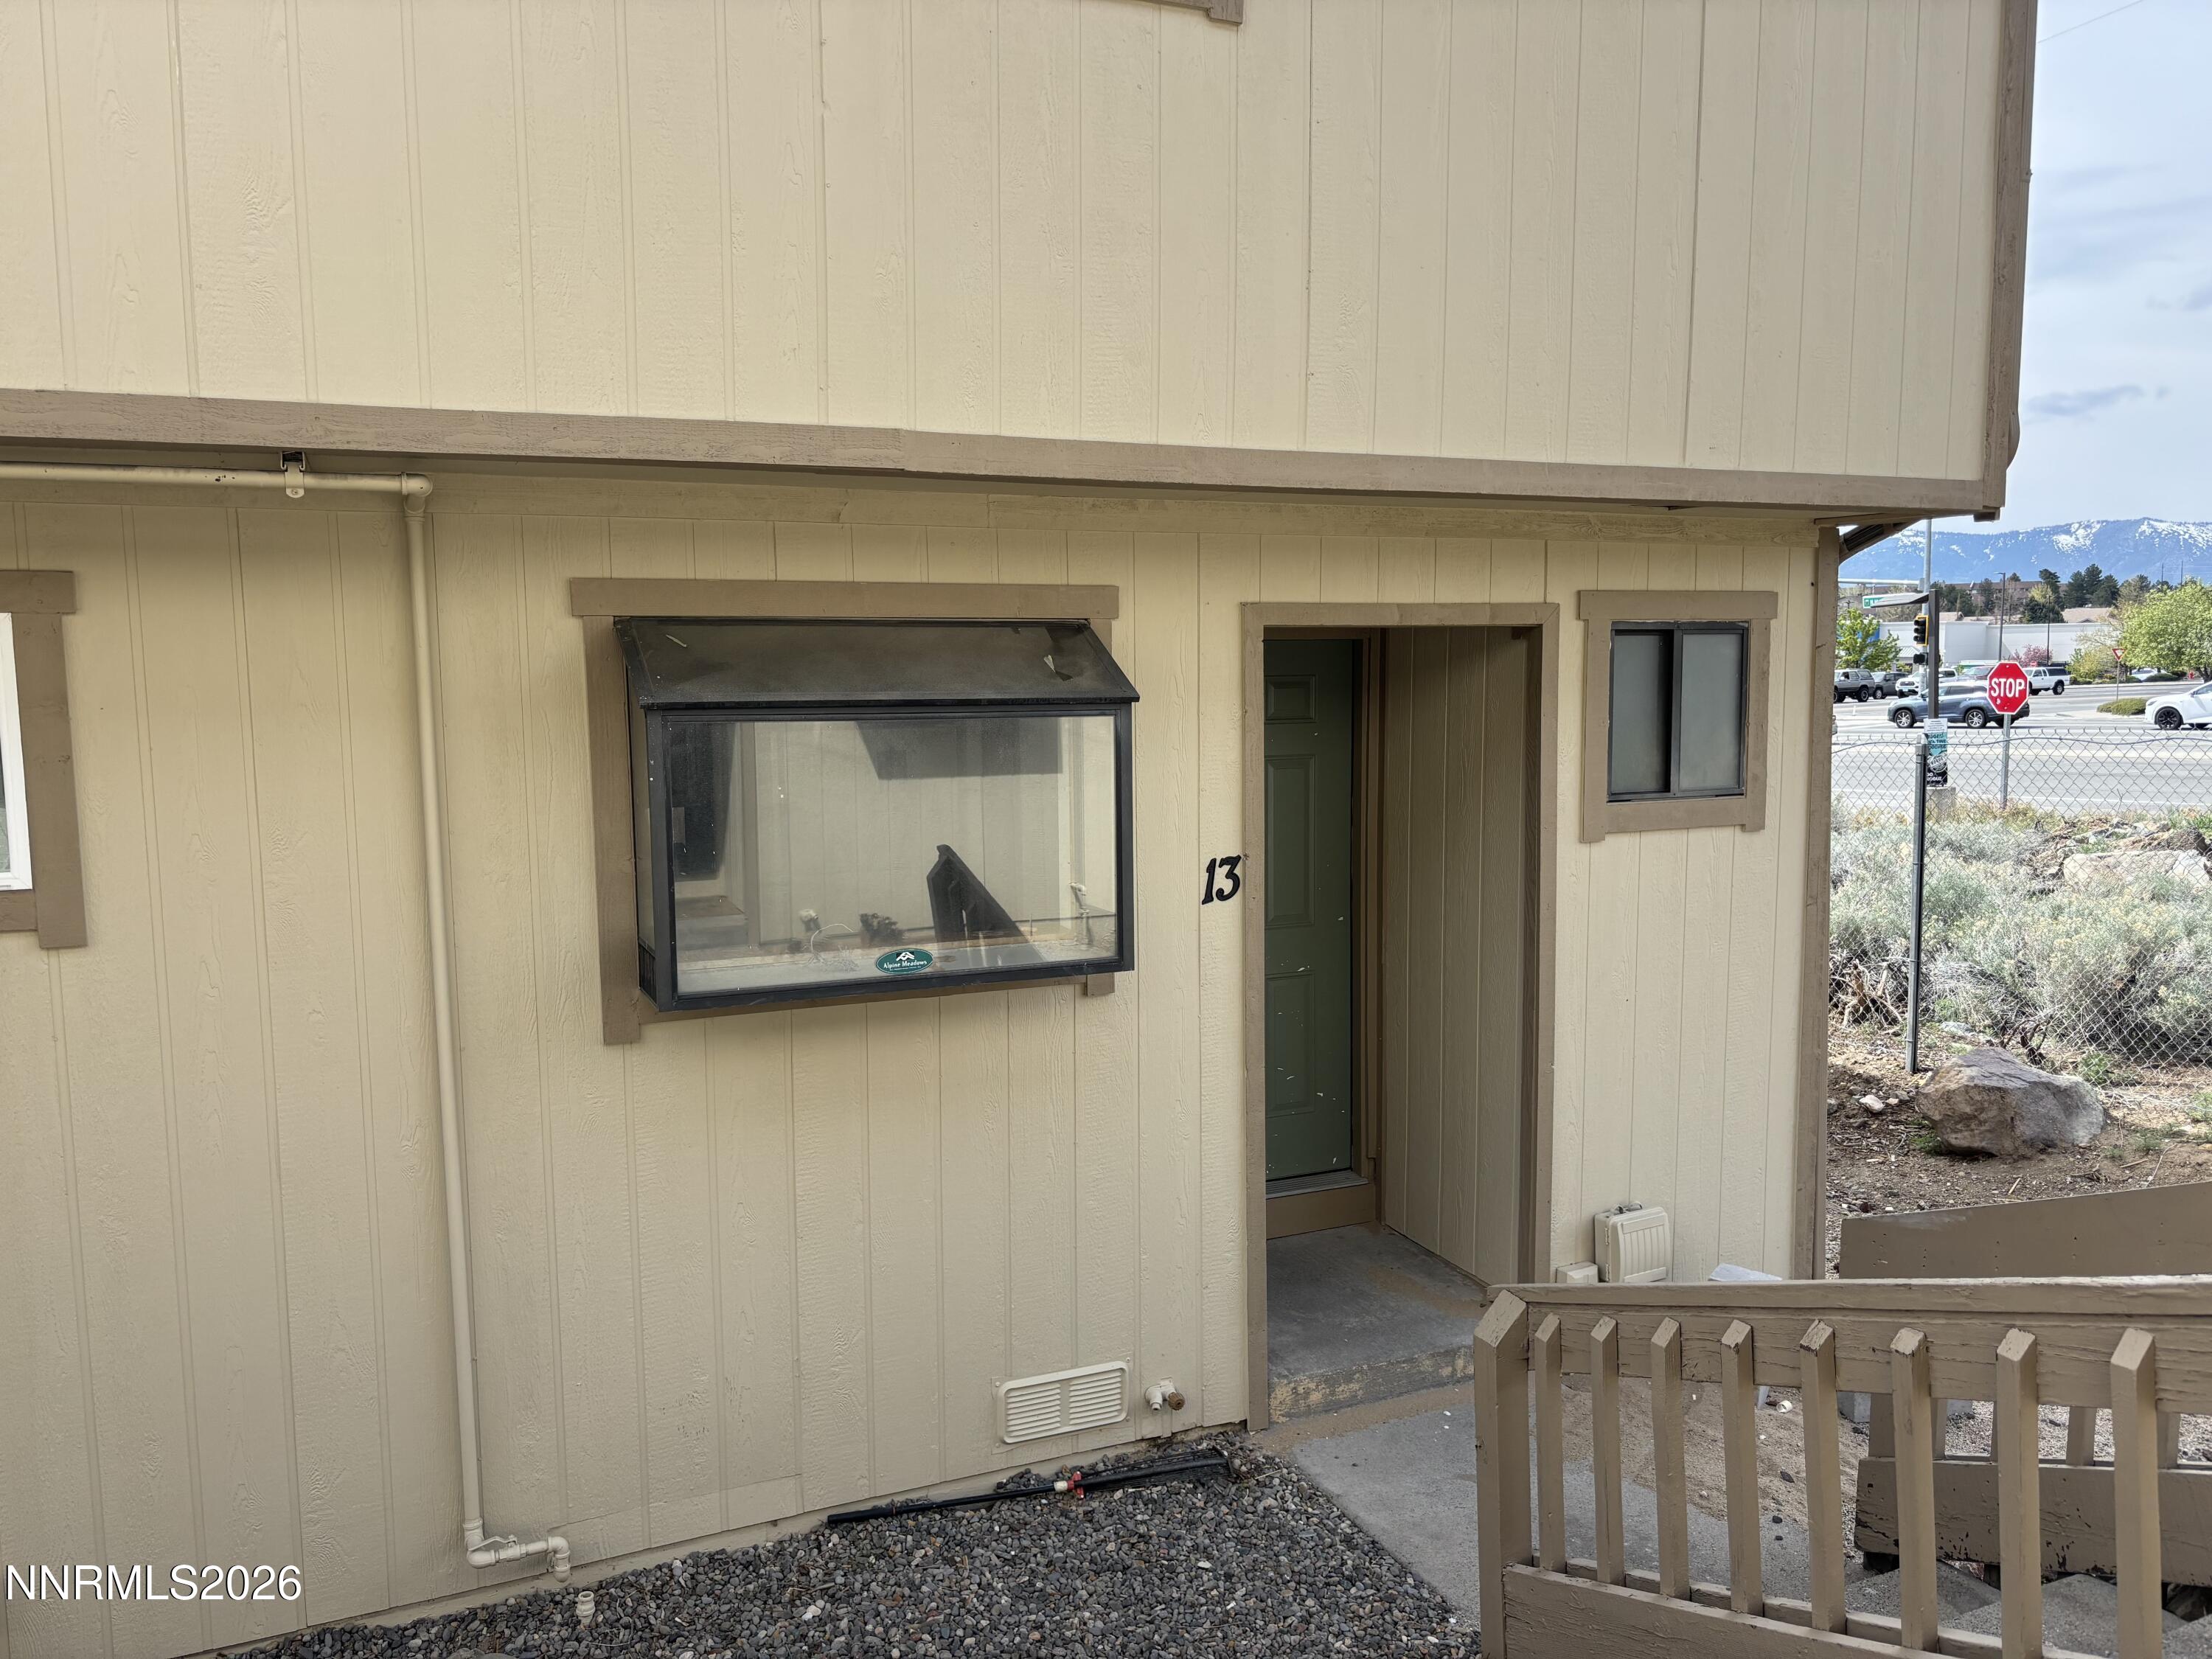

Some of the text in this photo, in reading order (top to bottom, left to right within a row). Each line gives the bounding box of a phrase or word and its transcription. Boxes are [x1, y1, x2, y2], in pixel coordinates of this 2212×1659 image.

[1991, 678, 2025, 698] STOP
[1202, 855, 1242, 905] 13
[883, 962, 900, 970] Alpine
